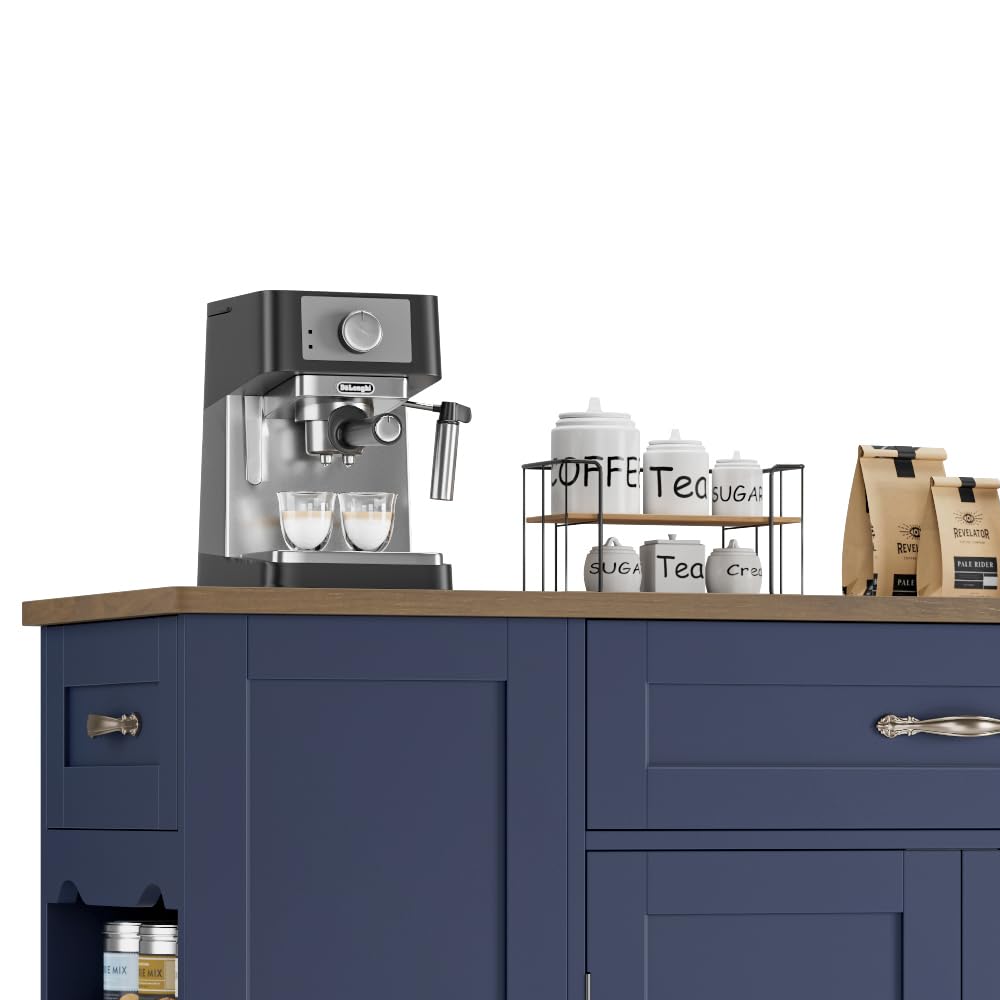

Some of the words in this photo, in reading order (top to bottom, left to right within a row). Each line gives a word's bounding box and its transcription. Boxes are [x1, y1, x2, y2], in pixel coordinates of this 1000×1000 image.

[649, 466, 707, 499] Tea
[952, 527, 991, 540] REVELATOR
[656, 555, 705, 579] Tea
[957, 560, 973, 568] PALE
[974, 561, 994, 569] RIDER
[897, 578, 916, 587] PALE
[113, 966, 127, 975] MIX
[147, 968, 163, 978] MIX
